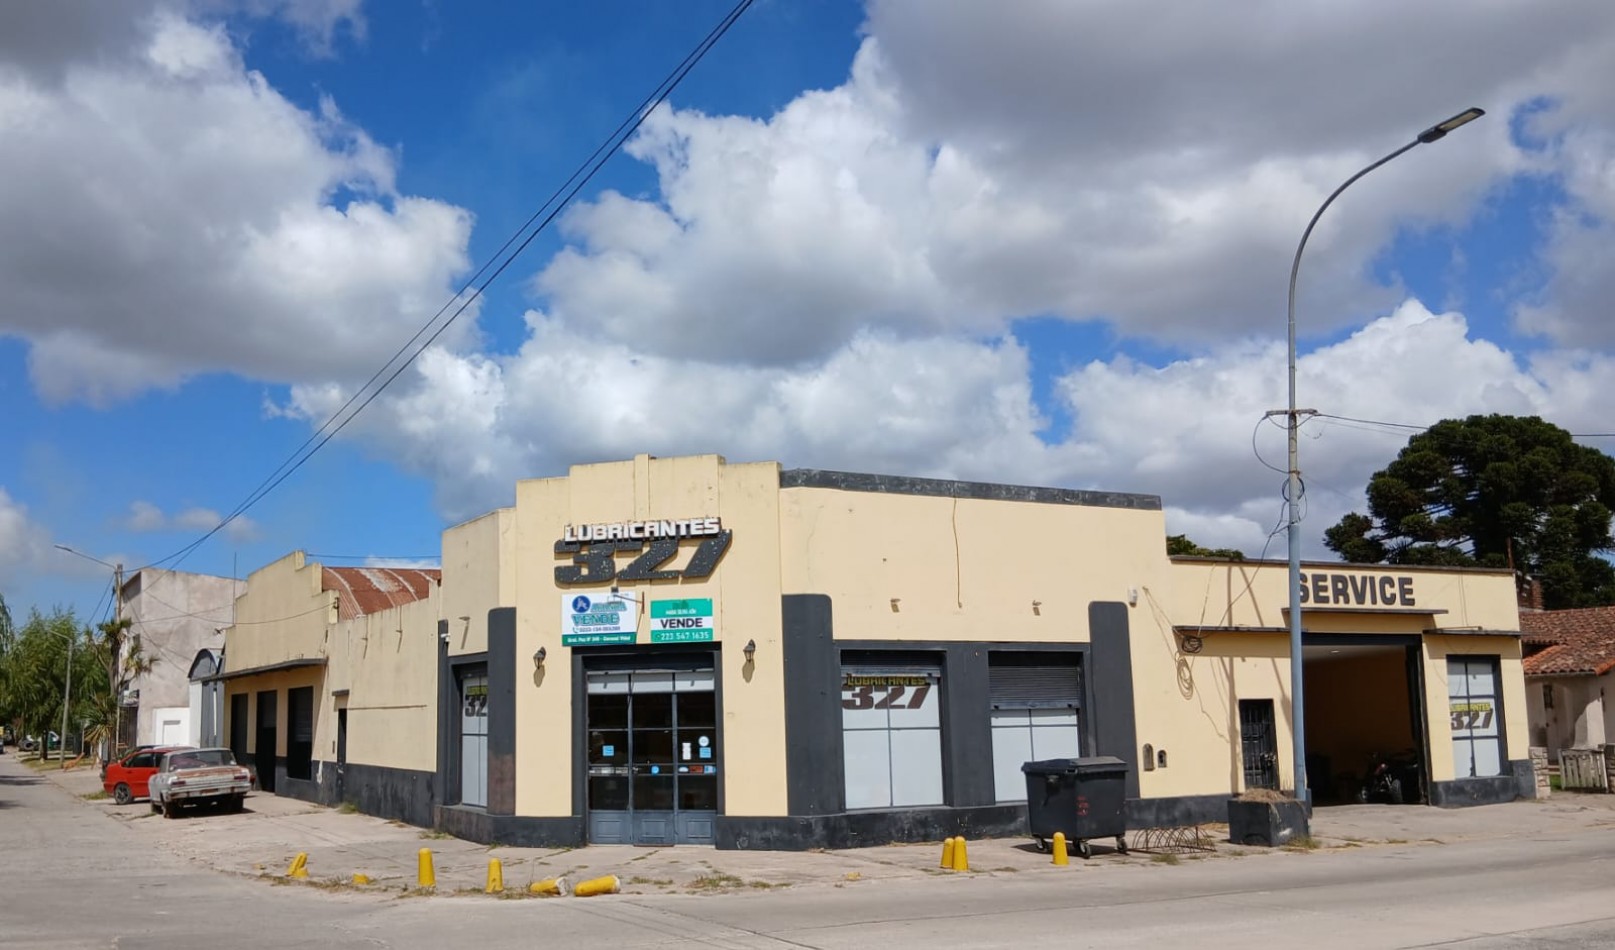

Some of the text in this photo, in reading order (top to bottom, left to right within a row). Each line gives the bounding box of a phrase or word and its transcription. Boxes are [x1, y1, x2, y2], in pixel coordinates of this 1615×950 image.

[564, 517, 720, 543] LUBRICANTES
[554, 529, 732, 584] 327
[1300, 573, 1415, 606] SERVICE
[571, 613, 620, 627] VENDE
[660, 618, 703, 629] VENDE
[465, 695, 488, 717] 32
[842, 684, 931, 710] 327
[1450, 708, 1493, 731] 327
